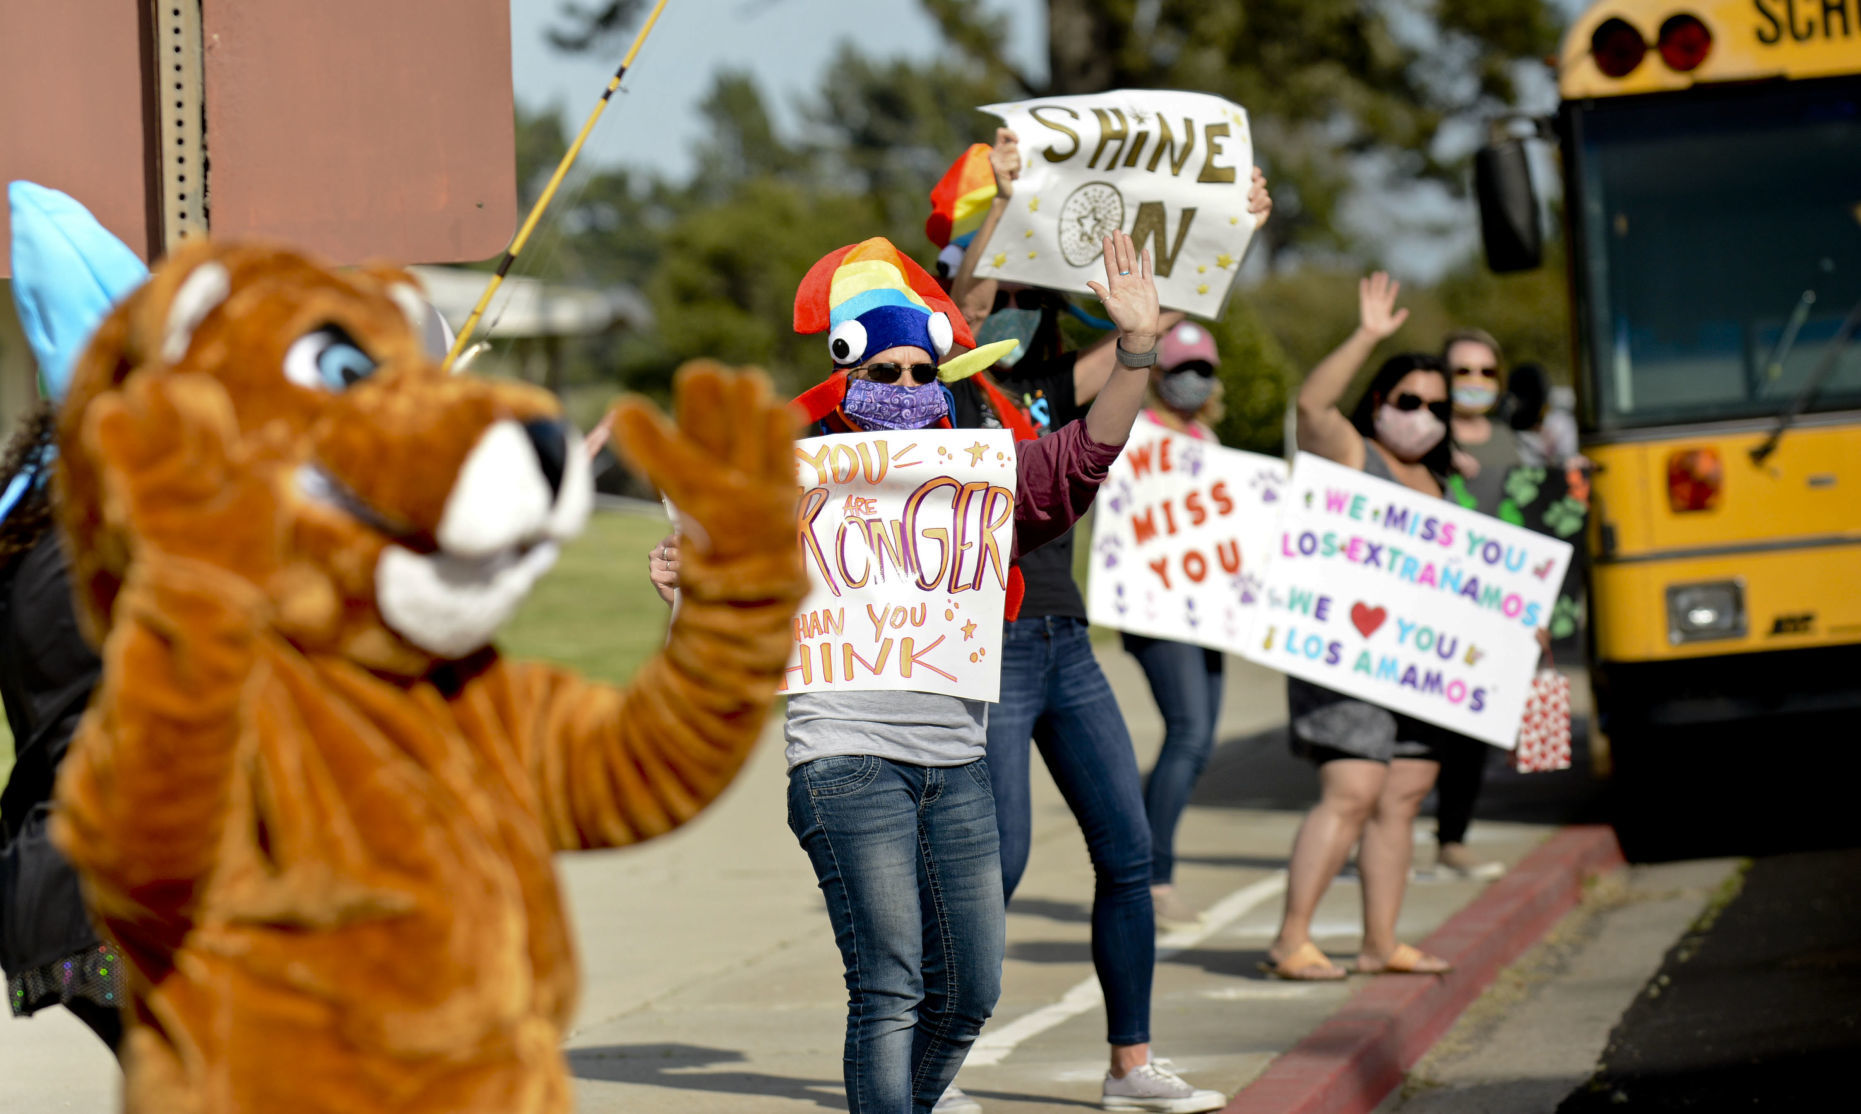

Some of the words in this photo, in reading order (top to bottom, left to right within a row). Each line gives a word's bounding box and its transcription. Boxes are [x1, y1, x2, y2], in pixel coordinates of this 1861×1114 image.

[1755, 0, 1861, 45] SCH
[795, 440, 888, 485] YOU
[1127, 437, 1172, 480] WE
[842, 493, 878, 517] ARE
[1131, 481, 1234, 546] MISS
[1325, 488, 1367, 520] WE
[1384, 504, 1457, 548] MISS
[1466, 528, 1527, 573] YOU
[797, 475, 1014, 597] RONGER
[1281, 530, 1338, 558] LOS
[1149, 538, 1242, 590] YOU
[794, 607, 844, 642] HAN
[866, 602, 927, 643] YOU
[1287, 586, 1332, 621] WE
[1397, 616, 1458, 660] YOU
[778, 634, 958, 691] HINK
[1285, 628, 1342, 666] LOS
[1353, 650, 1486, 713] AMAMOS
